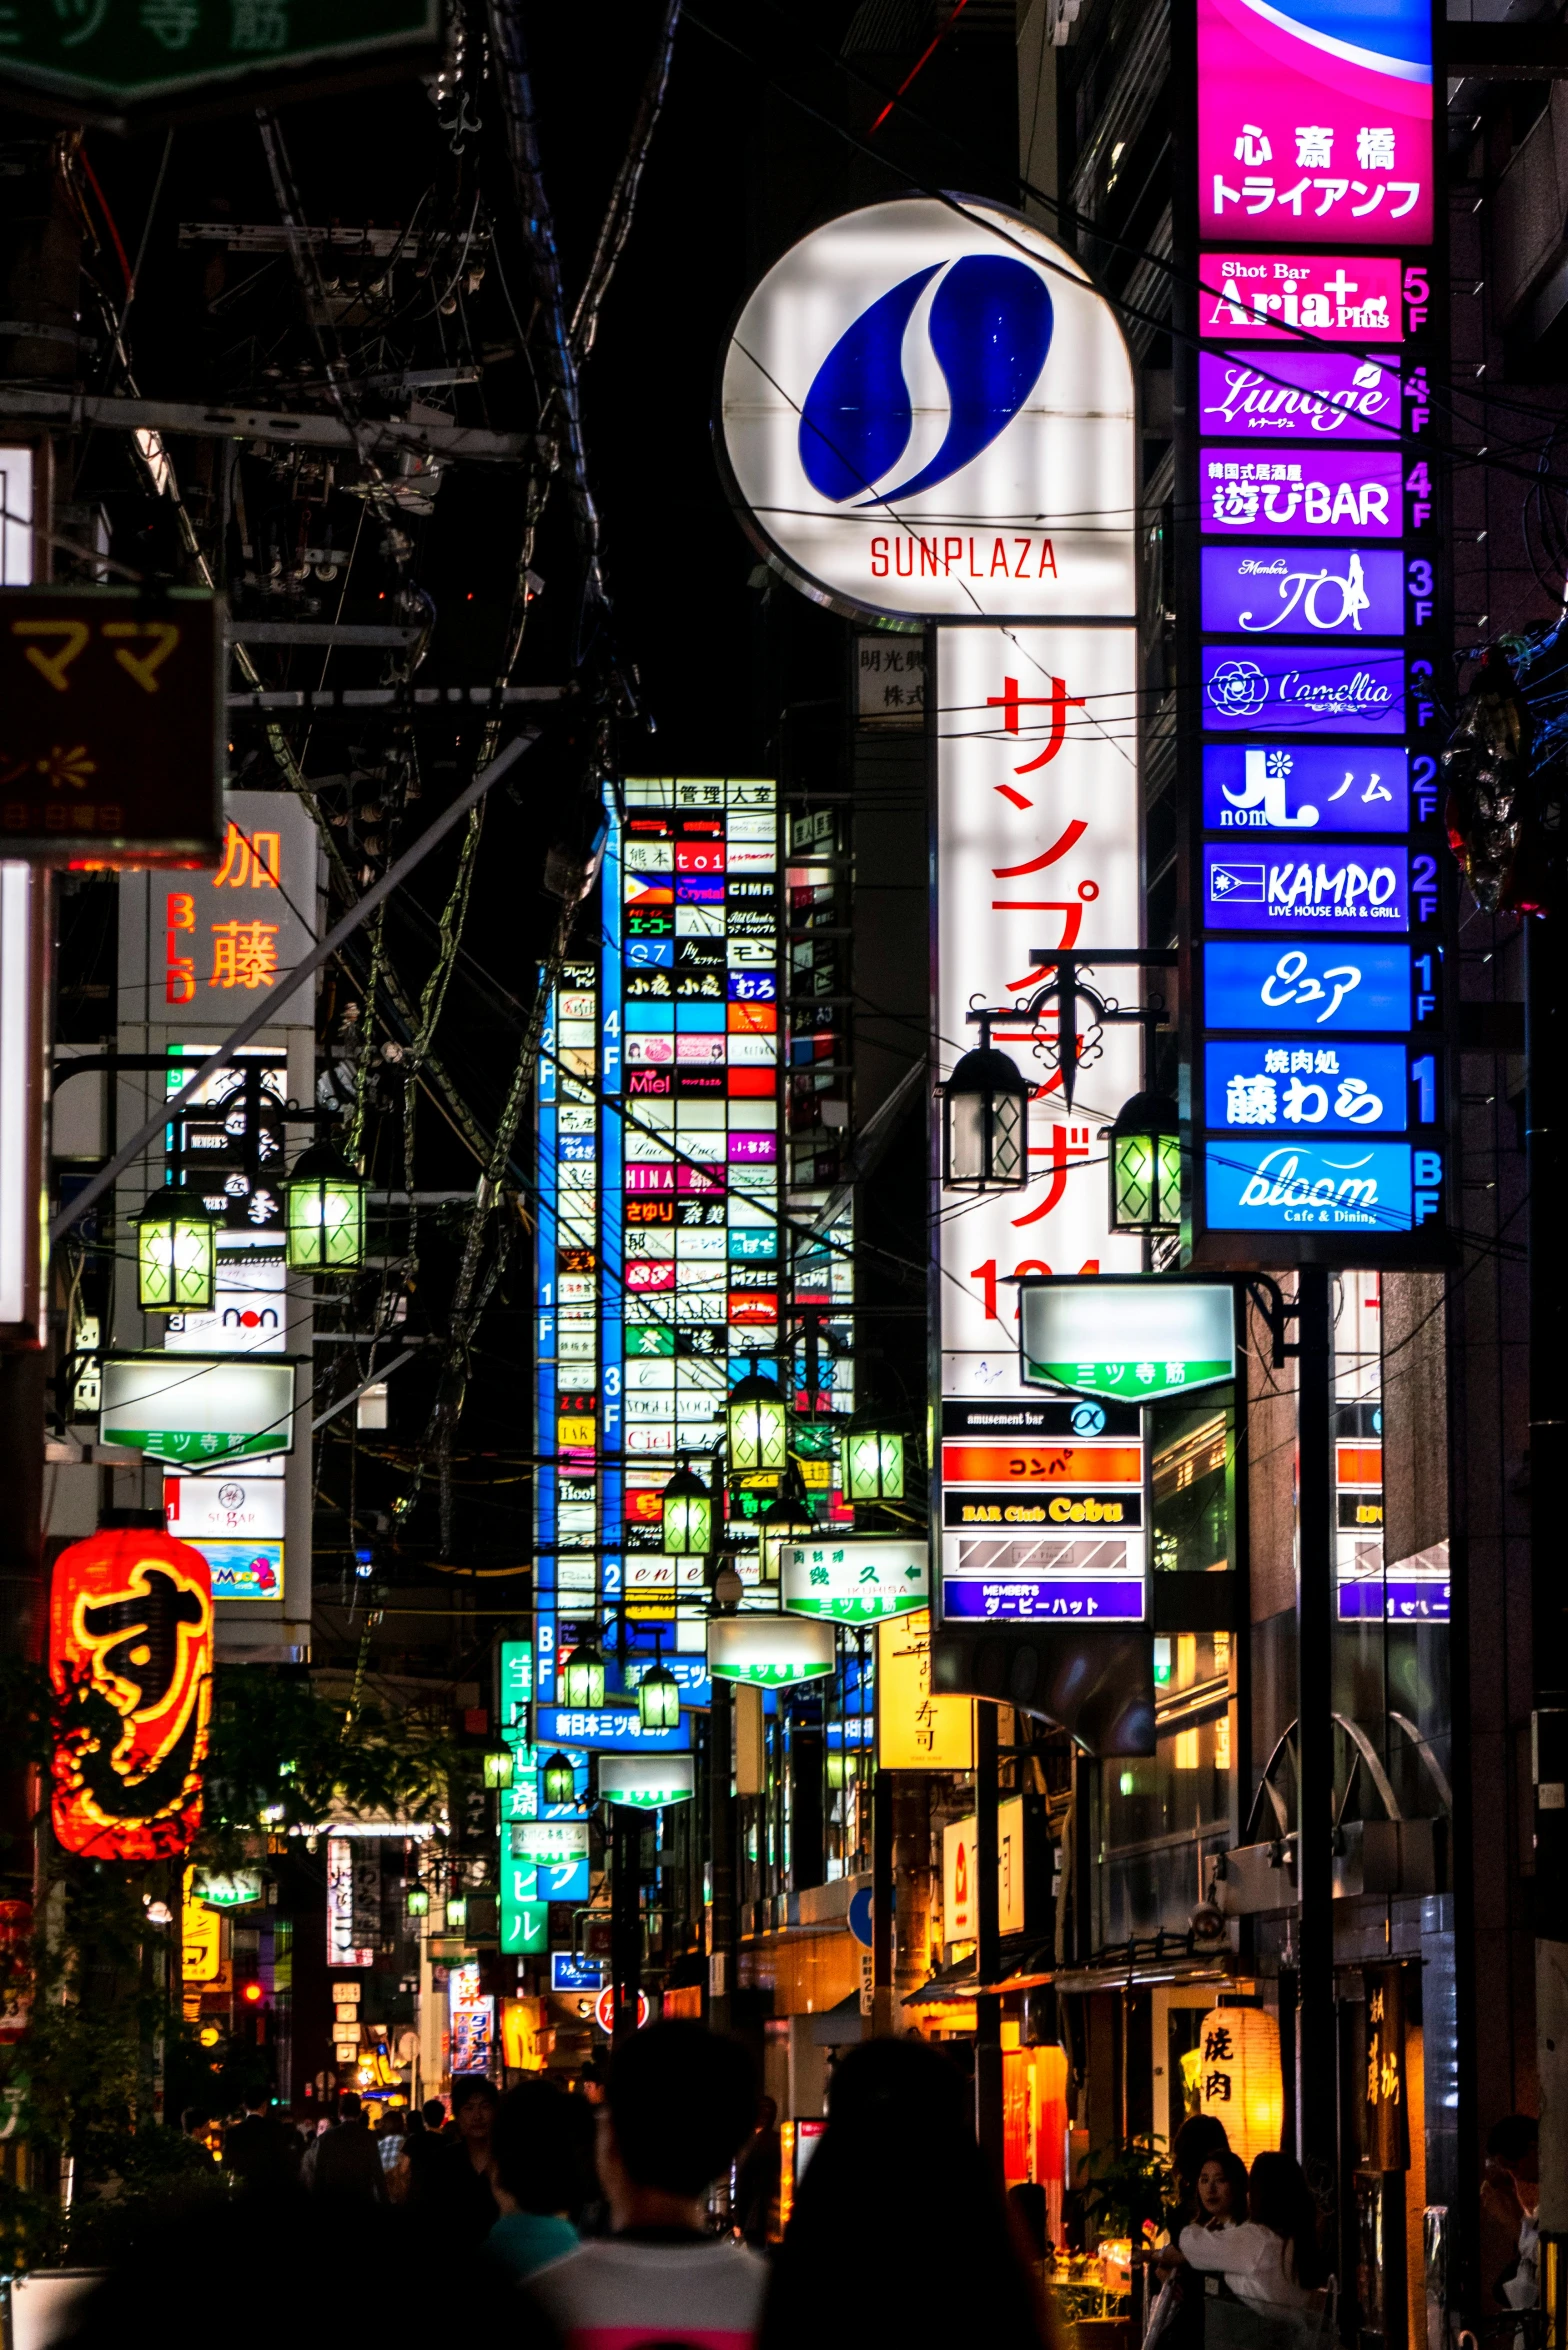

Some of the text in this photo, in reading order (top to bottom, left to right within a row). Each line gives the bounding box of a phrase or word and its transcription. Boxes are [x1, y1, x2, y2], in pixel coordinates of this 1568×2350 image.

[1234, 124, 1395, 170] 心斎橋
[1213, 174, 1420, 218] トライアンフ
[1221, 262, 1310, 280] Shot Bar
[1209, 279, 1336, 328] Aria
[1247, 417, 1295, 429] ルナージュ
[1207, 462, 1302, 481] 韓国式居酒屋
[1212, 480, 1390, 525] 遊びBAR
[870, 536, 1058, 579] SUNPLAZA
[1279, 670, 1393, 703] Camellia
[680, 785, 772, 804] 管理人室
[1327, 772, 1393, 803] ノム
[1220, 809, 1268, 827] nom
[630, 848, 670, 868] 熊本
[1267, 863, 1397, 908] KAMPO
[209, 823, 281, 988] 加藤
[1269, 905, 1401, 918] LIVE HOUSE BAR & GRILL
[630, 944, 667, 963] G7
[736, 978, 775, 999] むろ
[1265, 1049, 1340, 1075] 焼肉処
[629, 1075, 670, 1093] Miel
[1412, 1056, 1435, 1123] 1
[1226, 1074, 1384, 1125] 藤わら
[626, 1169, 674, 1189] HINA
[626, 1201, 673, 1222] さゆり
[1284, 1209, 1377, 1224] Cafe & Dining
[1076, 1361, 1186, 1385] 三ツ寺筋
[967, 1412, 1045, 1426] amusement bar
[146, 1433, 246, 1453] 三ツ寺筋
[627, 1430, 671, 1449] Ciel
[1009, 1449, 1073, 1476] コンパ
[962, 1497, 1123, 1523] BAR Club Cebu
[793, 1549, 844, 1564] 肉料理
[809, 1565, 880, 1586] 幾久
[848, 1585, 908, 1595] IKUHISA
[983, 1585, 1040, 1597] MEMBER'S
[819, 1597, 897, 1615] 三ツ寺筋
[985, 1597, 1099, 1616] ダービーハット
[1204, 2027, 1234, 2102] 焼肉
